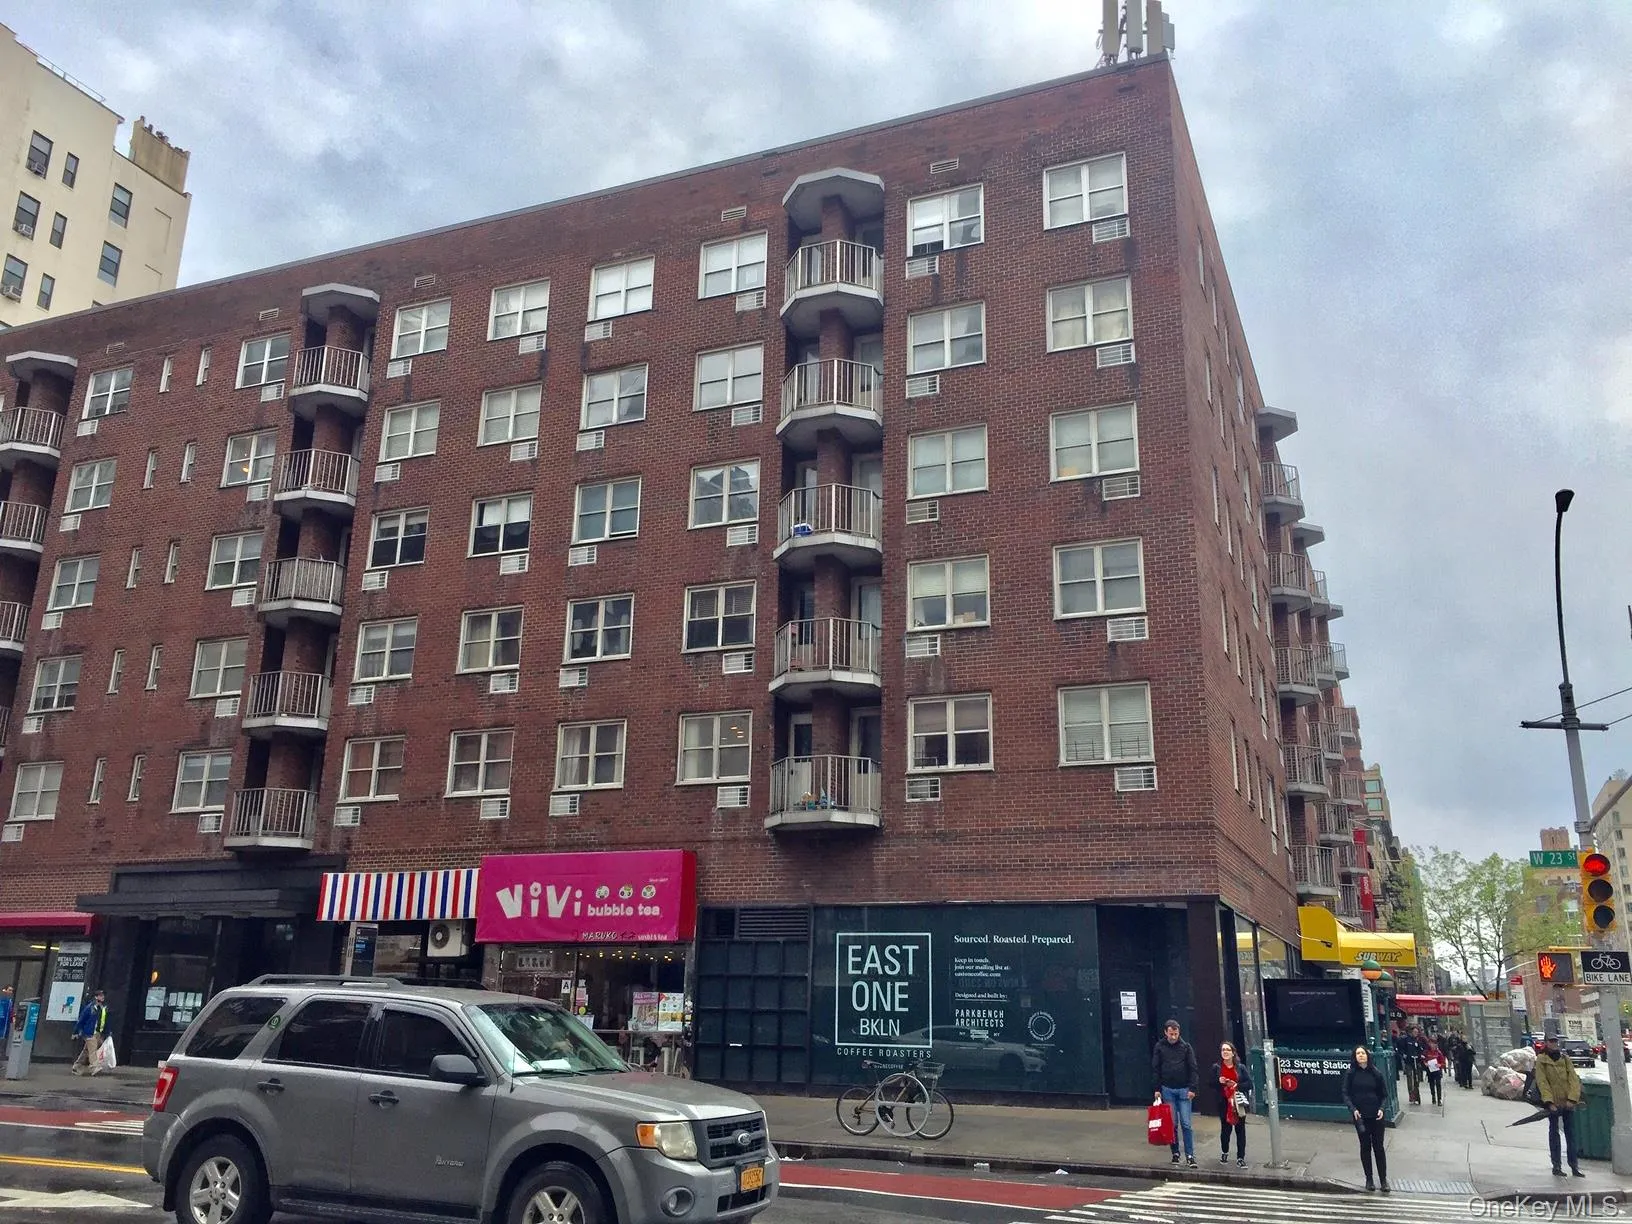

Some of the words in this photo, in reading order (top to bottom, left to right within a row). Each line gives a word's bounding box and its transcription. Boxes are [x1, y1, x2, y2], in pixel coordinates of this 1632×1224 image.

[1533, 853, 1544, 865] W
[1551, 852, 1563, 865] 23
[1568, 853, 1576, 861] St
[496, 882, 583, 919] ViVi
[588, 903, 633, 917] bubble
[637, 903, 660, 917] tea
[582, 931, 617, 941] MARUKO
[954, 934, 991, 944] Sourced.
[993, 934, 1029, 944] Roasted.
[1031, 934, 1074, 946] Prepared.
[848, 944, 919, 975] EAST
[1356, 951, 1402, 963] SUBWAY
[1585, 973, 1604, 983] BIKE
[1608, 972, 1630, 983] LANE
[852, 980, 909, 1012] ONE
[955, 1009, 1004, 1018] PARKBENCH
[860, 1018, 900, 1037] BKLN
[955, 1018, 1004, 1028] ARCHITECTS
[837, 1047, 873, 1057] COFFEE
[879, 1048, 931, 1059] ROASTERS
[1280, 1060, 1291, 1068] 23
[1294, 1060, 1320, 1069] Street
